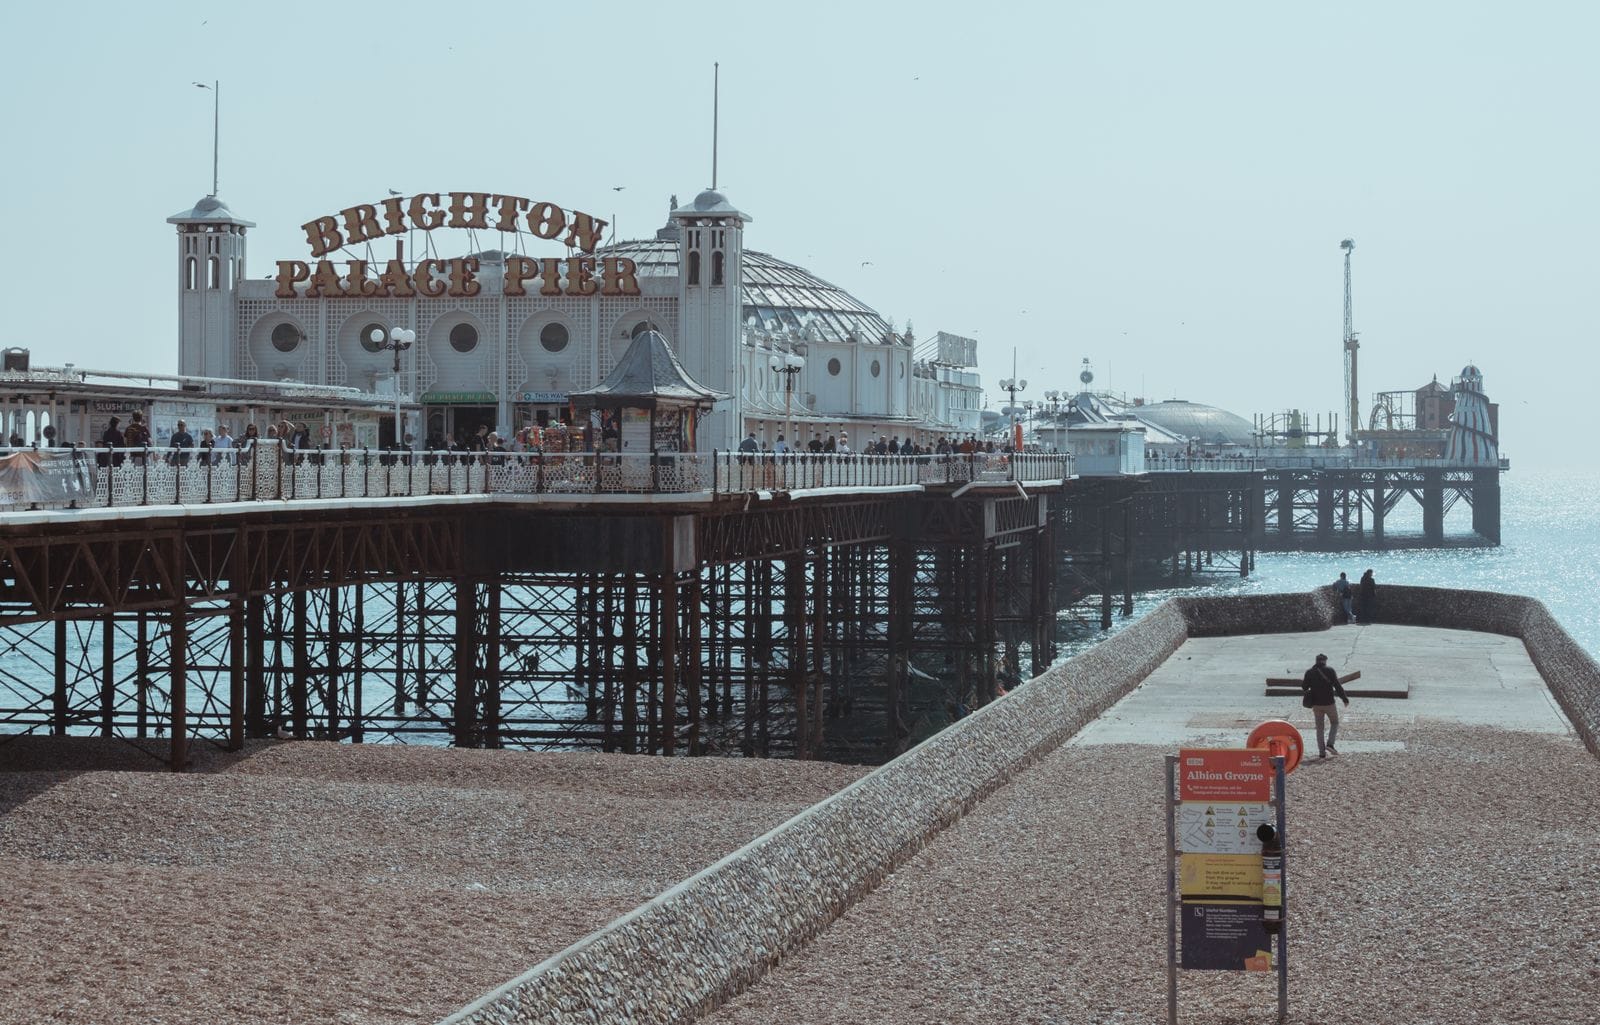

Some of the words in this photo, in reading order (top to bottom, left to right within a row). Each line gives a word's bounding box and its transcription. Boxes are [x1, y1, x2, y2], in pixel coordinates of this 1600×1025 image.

[301, 191, 609, 257] BRIGHTON
[275, 258, 482, 298] PALACE
[503, 257, 641, 297] PIER
[96, 402, 123, 411] SLUSH
[125, 403, 142, 411] BAR
[1187, 771, 1223, 780] Albion
[1224, 771, 1264, 782] Groyne
